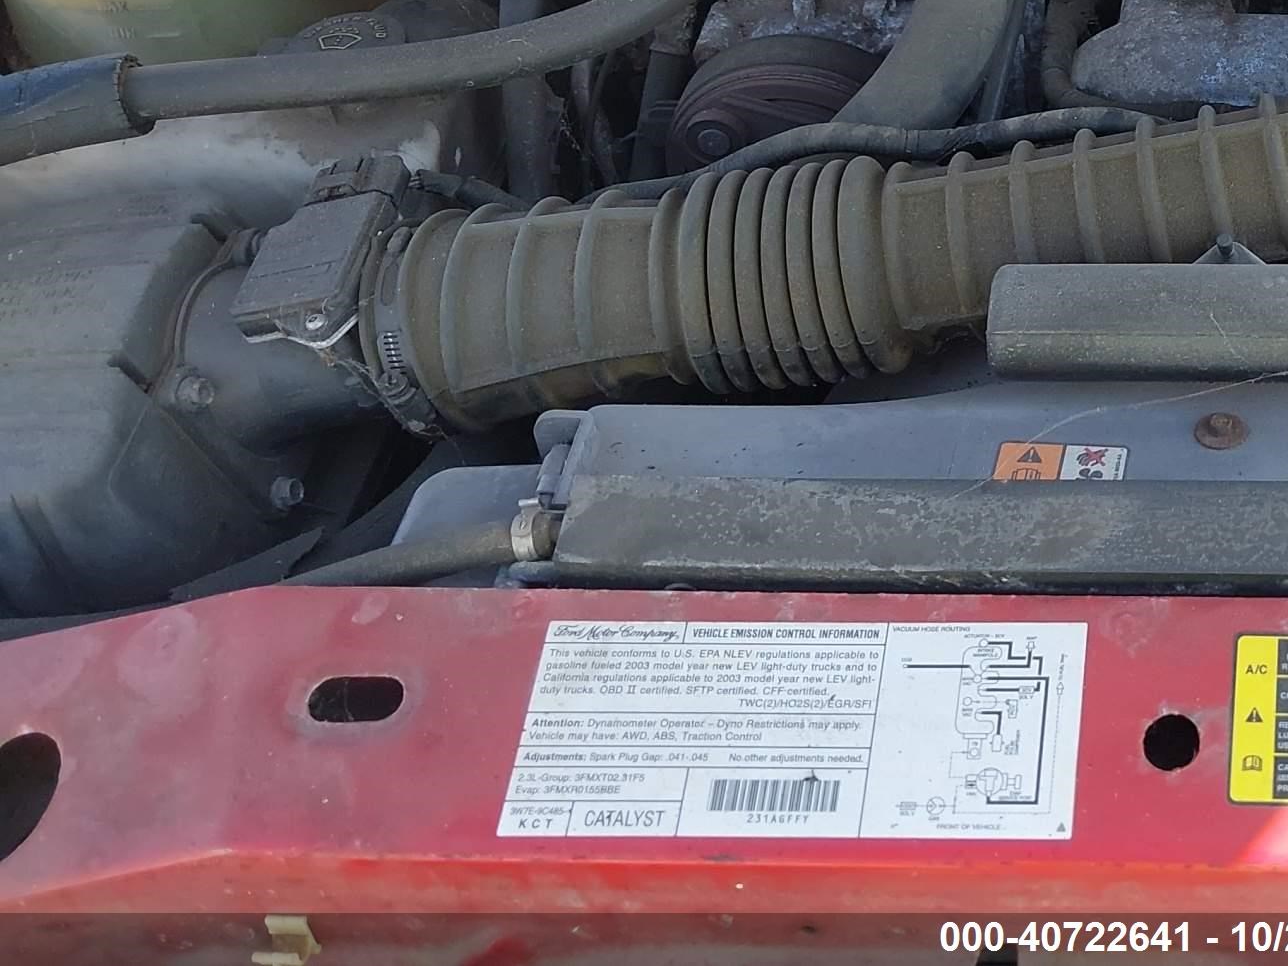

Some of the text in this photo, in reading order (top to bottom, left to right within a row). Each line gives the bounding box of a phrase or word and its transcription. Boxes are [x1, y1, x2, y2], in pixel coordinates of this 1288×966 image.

[693, 628, 880, 640] VEHICLE EMISSION CONTROL INFORMATION
[550, 648, 879, 661] This vehicle conforms to U.S. EPA NLEV regulations applicable to
[545, 662, 587, 672] gasoline
[591, 661, 622, 670] fueled
[624, 662, 649, 670] 2003
[653, 662, 684, 670] model
[687, 663, 709, 672] year
[737, 662, 757, 671] LEV
[761, 662, 808, 673] light-duty
[811, 663, 841, 671] trucks
[845, 663, 863, 671] and
[867, 663, 878, 672] to
[1245, 664, 1268, 675] A/C
[543, 673, 876, 685] California regulations applicable to 2003 model year new LEV light-
[540, 686, 560, 697] duty
[600, 686, 624, 695] OBD
[627, 686, 636, 695] II
[640, 686, 682, 695] certified.
[685, 687, 714, 695] SFTP
[716, 687, 759, 696] certified.
[532, 718, 584, 728] Attention:
[587, 719, 657, 730] Dynamometer
[660, 719, 705, 730] Operator
[717, 719, 743, 731] Dyno
[746, 719, 805, 729] Restrictions
[808, 722, 829, 732] may
[529, 731, 565, 741] Vehicle
[568, 733, 587, 742] may
[591, 732, 617, 741] have:
[653, 732, 678, 743] ABS,
[682, 732, 722, 742] Traction
[725, 732, 762, 742] Control
[523, 752, 587, 762] Adjustments:
[590, 752, 615, 762] Spark
[618, 752, 638, 763] Plug
[641, 752, 664, 763] Gap:
[729, 753, 741, 762] No
[744, 753, 767, 762] other
[770, 753, 825, 765] adjustments
[827, 754, 864, 764] needed.
[515, 785, 539, 796] Evap:
[584, 810, 665, 827] CATALYST
